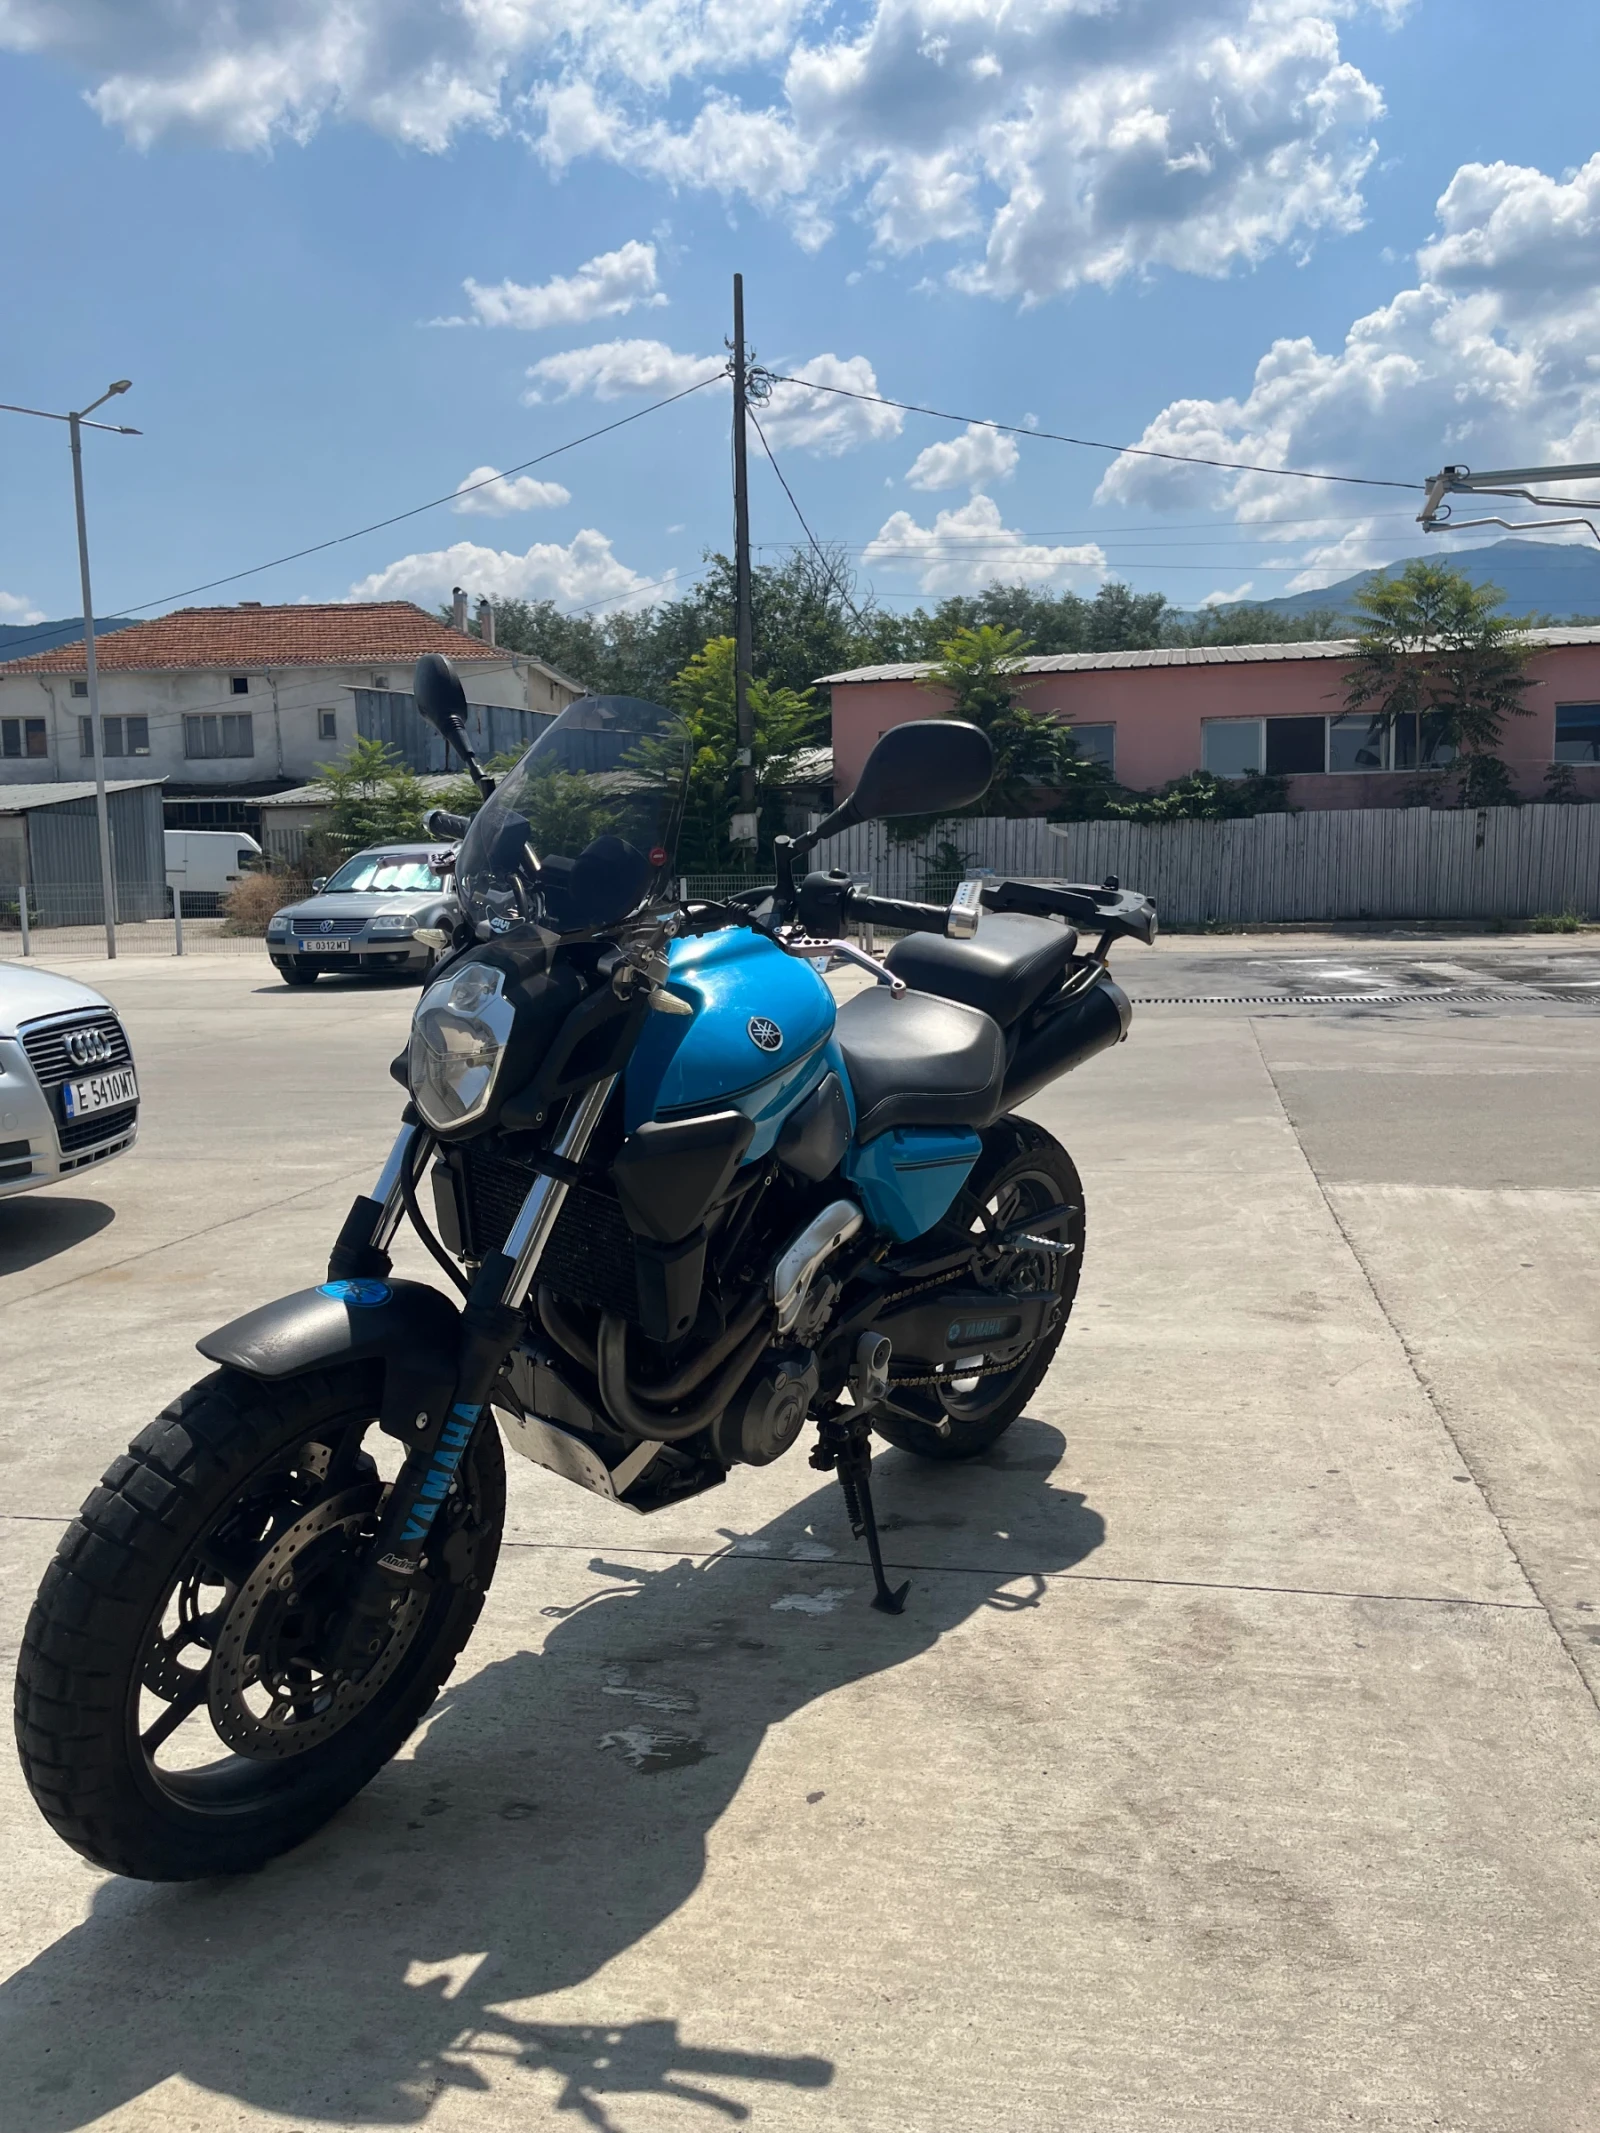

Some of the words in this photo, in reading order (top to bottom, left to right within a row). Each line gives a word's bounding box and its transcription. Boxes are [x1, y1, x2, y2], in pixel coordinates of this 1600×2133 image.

[491, 917, 511, 931] GIVI
[306, 941, 313, 950] E
[315, 941, 347, 950] 0312MT
[76, 1083, 89, 1110] E
[90, 1070, 134, 1106] 5410MT
[964, 1319, 1001, 1339] YAMAHA
[400, 1403, 483, 1541] YAMAHA
